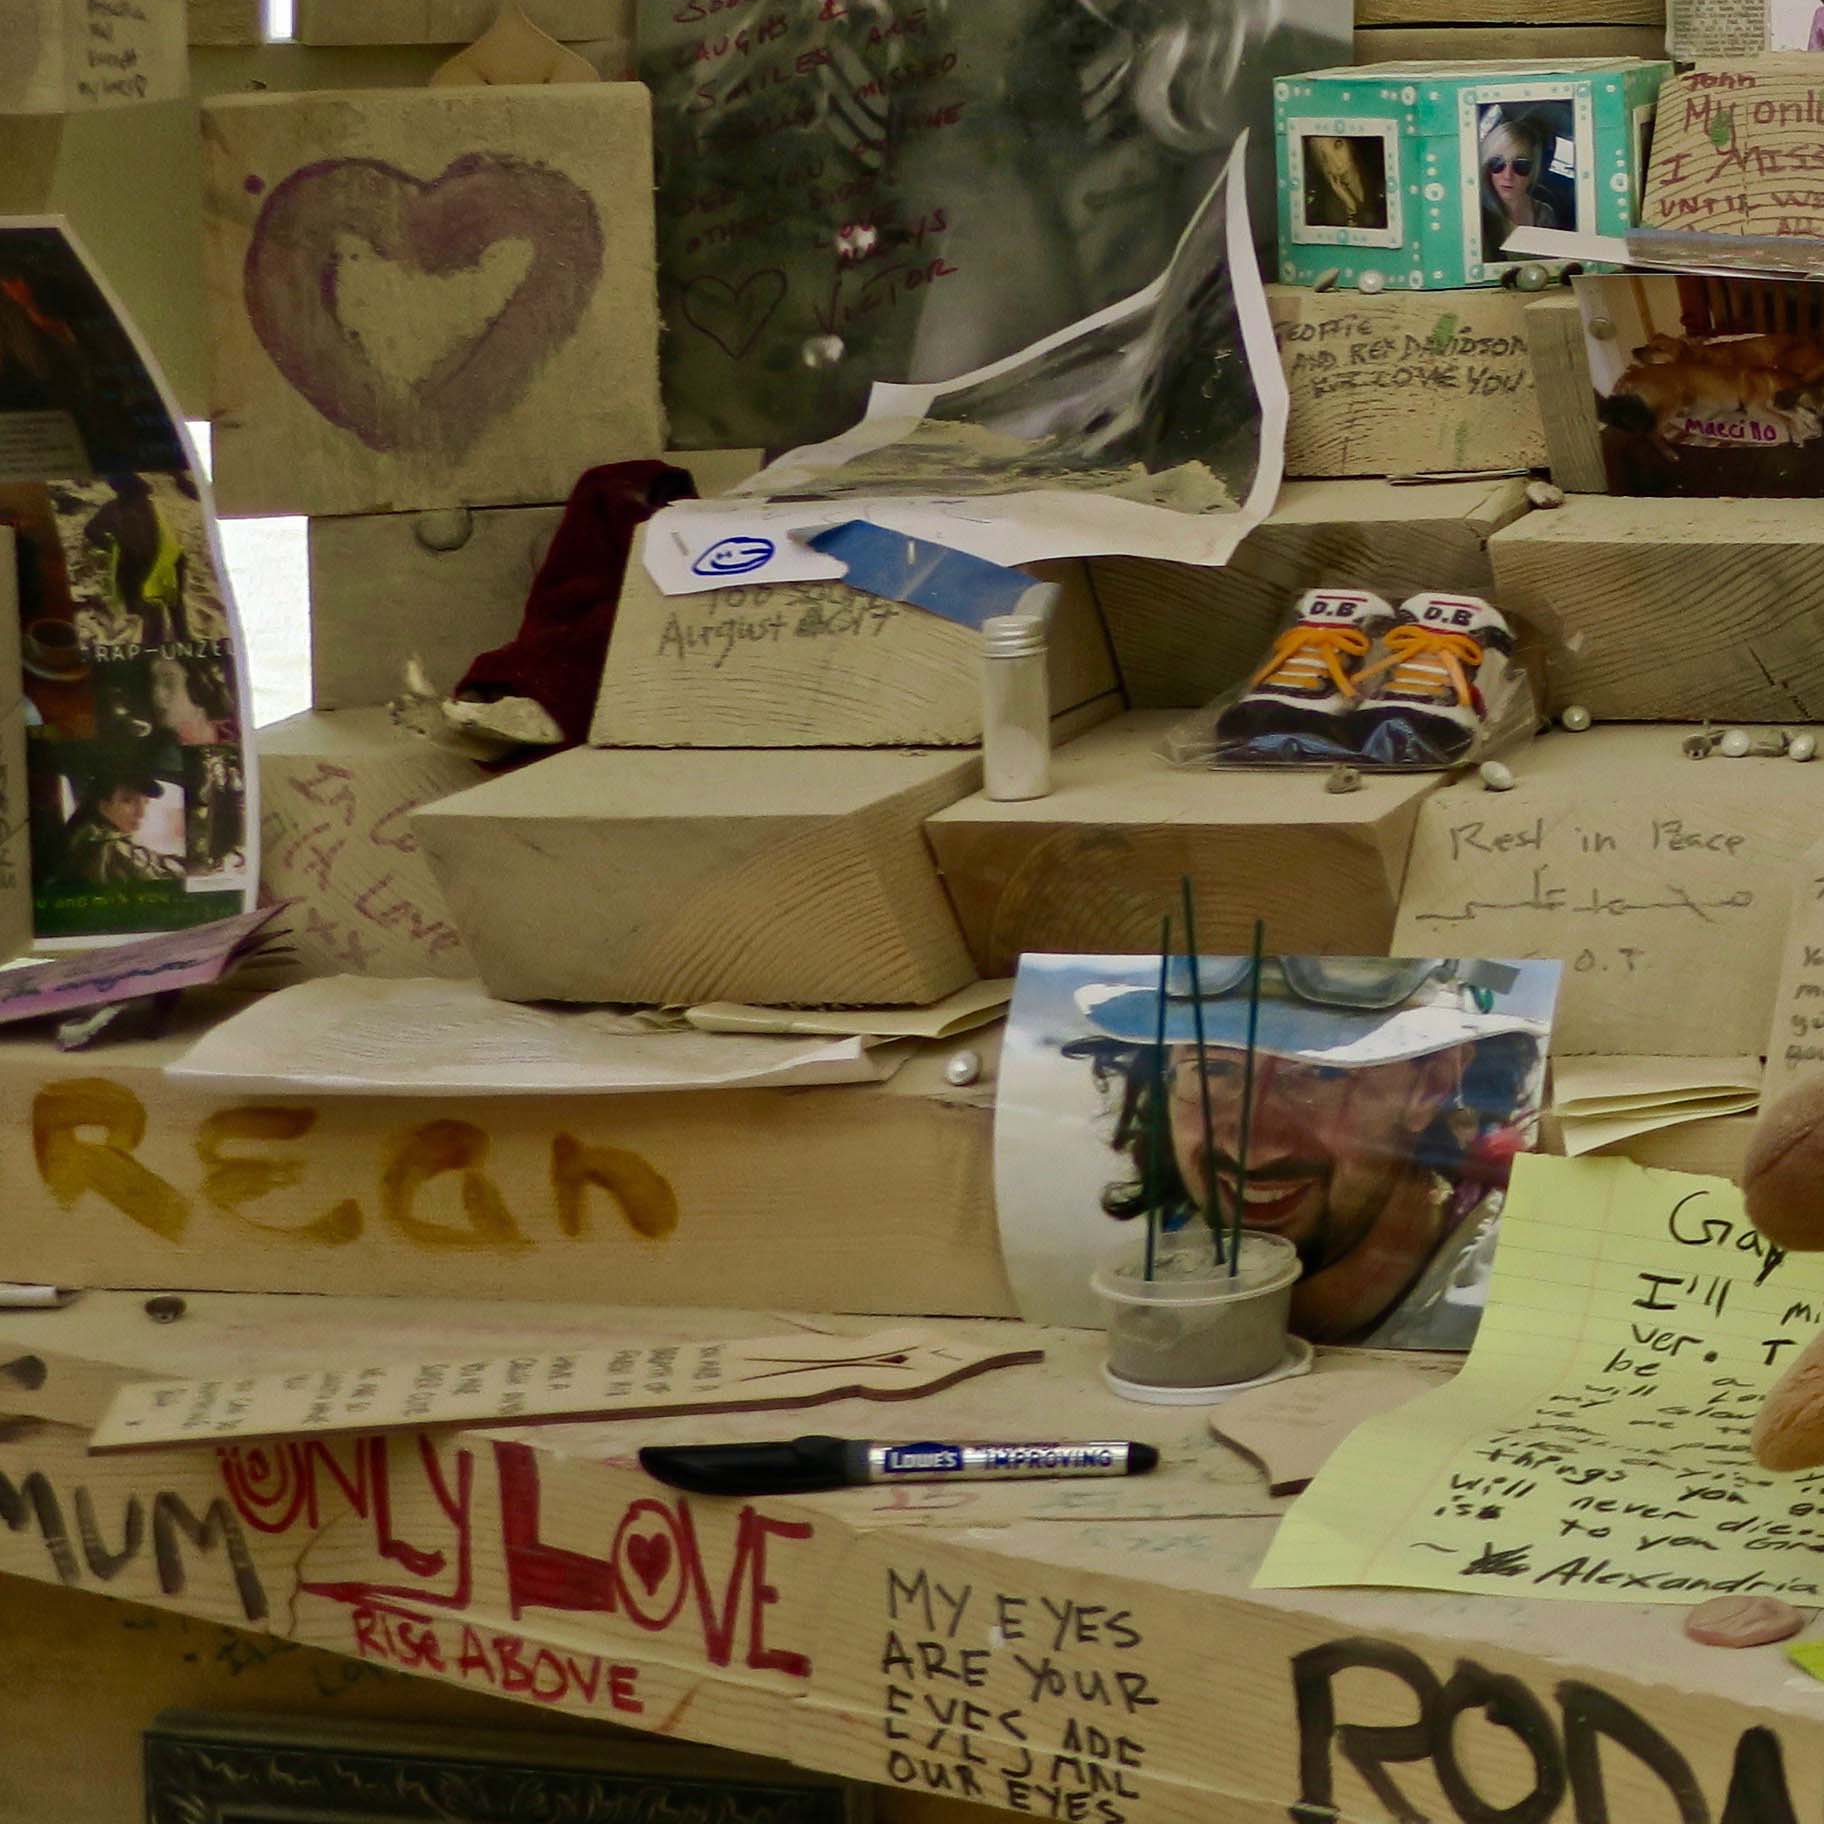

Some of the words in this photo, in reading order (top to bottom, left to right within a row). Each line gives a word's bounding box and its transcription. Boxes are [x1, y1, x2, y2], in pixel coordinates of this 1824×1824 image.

[1310, 600, 1357, 617] D.B
[1423, 606, 1472, 626] D.B
[887, 1566, 973, 1638] MY
[996, 1591, 1144, 1654] EYES
[458, 1626, 645, 1715] ABOVE
[881, 1629, 992, 1687] ARE
[1013, 1652, 1161, 1714] YOUR
[886, 1749, 984, 1797] OUR
